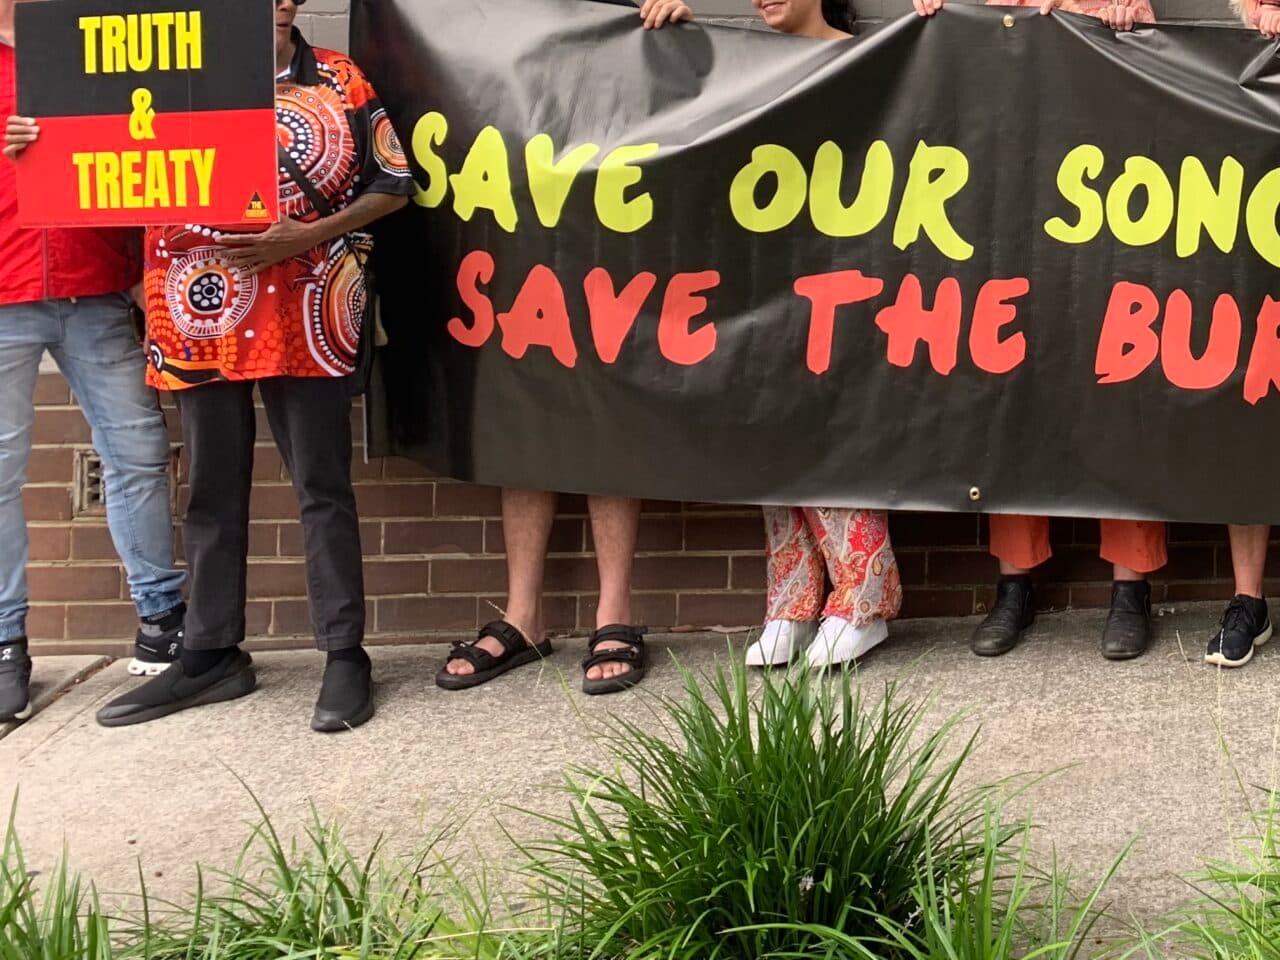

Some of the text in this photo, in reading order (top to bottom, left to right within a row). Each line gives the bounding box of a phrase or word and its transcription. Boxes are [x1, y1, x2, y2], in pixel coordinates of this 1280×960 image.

[79, 10, 202, 73] TRUTH
[129, 88, 156, 140] &
[72, 148, 216, 209] TREATY
[411, 111, 658, 232] SAVE
[730, 140, 974, 260] OUR
[447, 250, 720, 368] SAVE
[793, 269, 1030, 376] THE
